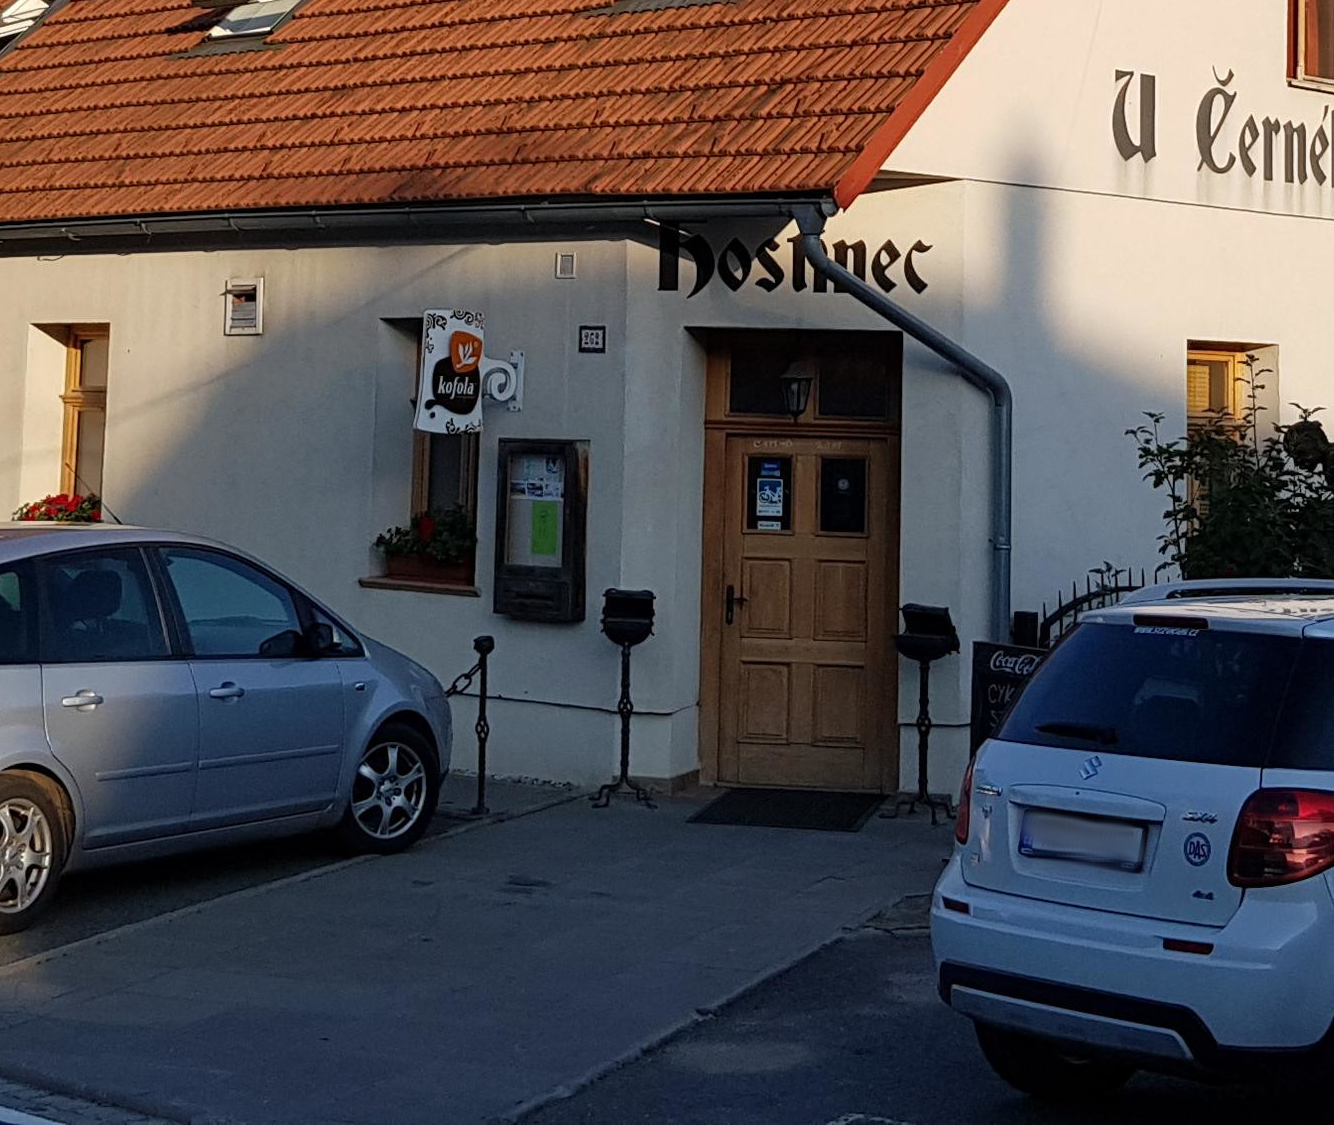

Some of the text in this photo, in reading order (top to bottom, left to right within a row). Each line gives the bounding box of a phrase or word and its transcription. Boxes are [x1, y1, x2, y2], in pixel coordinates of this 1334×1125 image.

[1112, 69, 1157, 164] U
[437, 375, 475, 400] kofola
[1188, 840, 1207, 860] DAS
